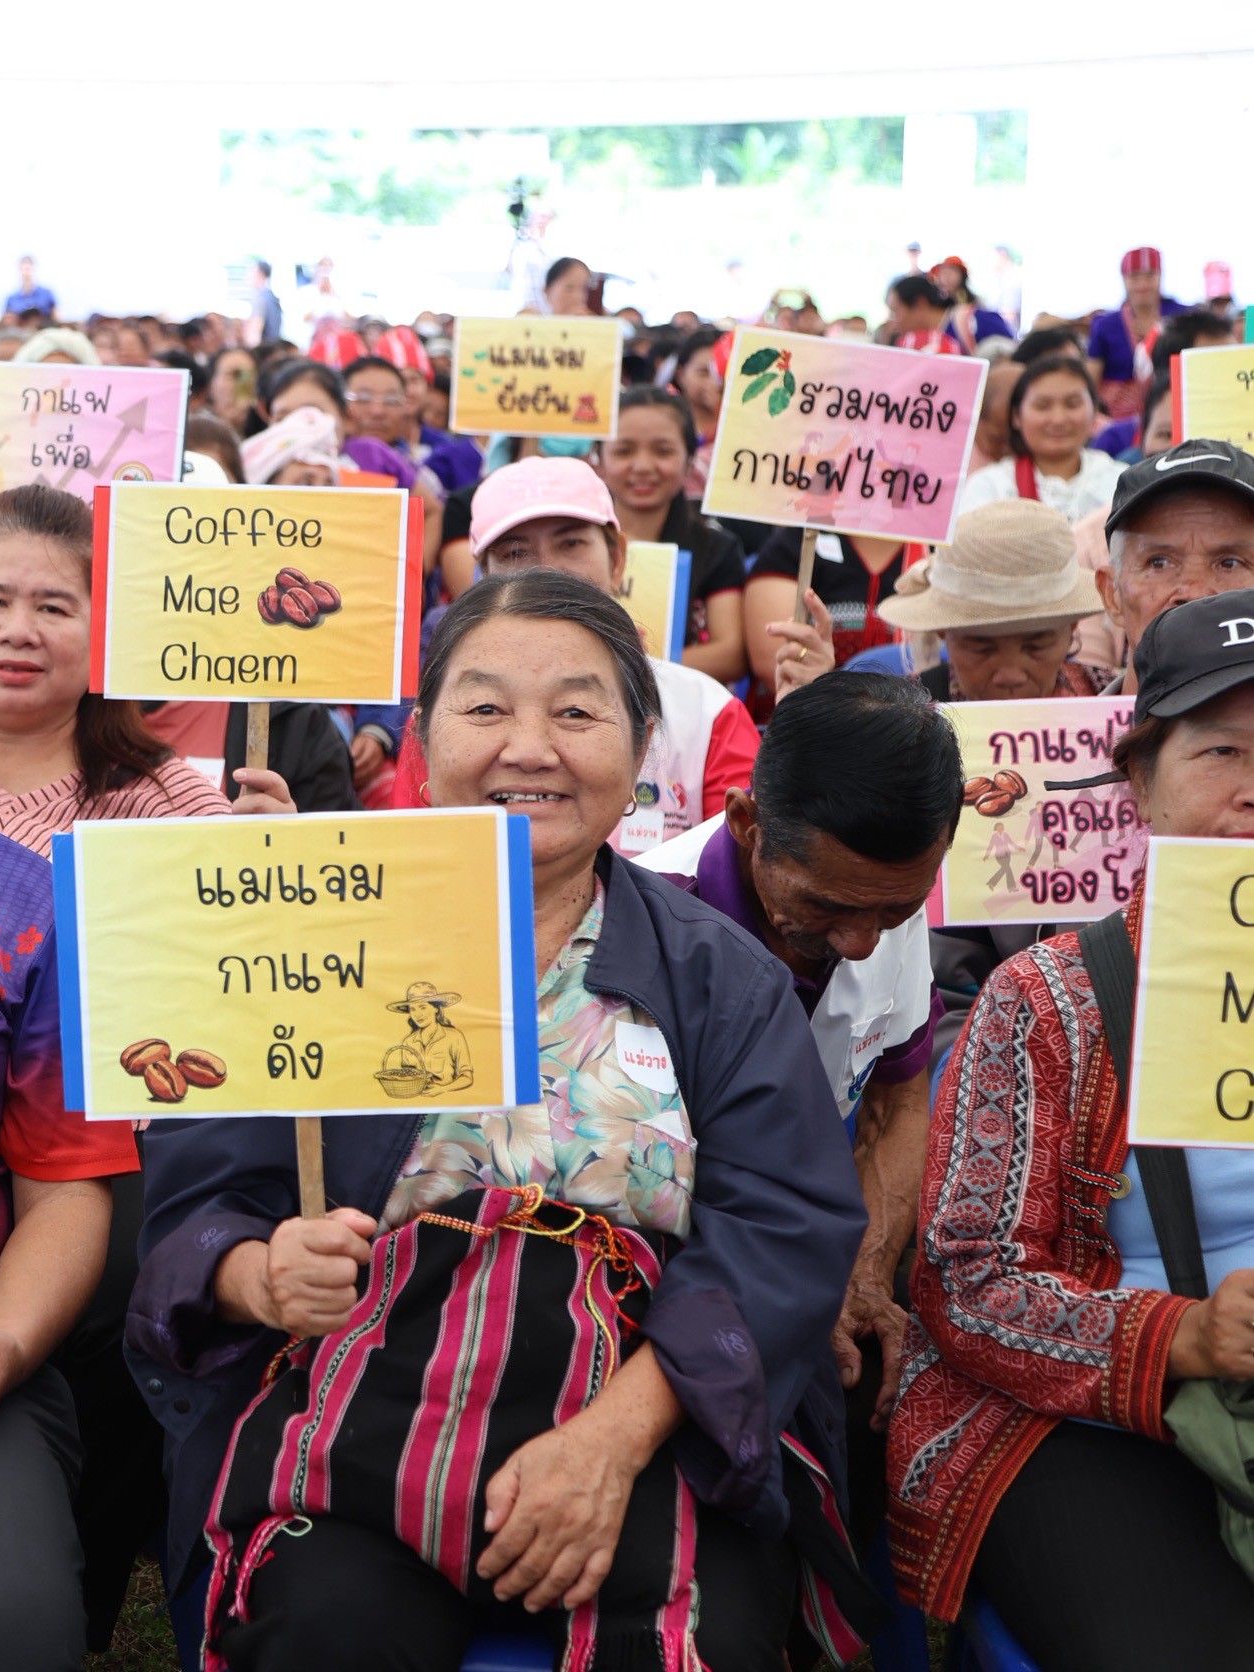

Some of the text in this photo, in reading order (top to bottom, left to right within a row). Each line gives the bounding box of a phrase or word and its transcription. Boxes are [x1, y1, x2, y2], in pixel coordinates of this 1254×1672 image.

[22, 384, 112, 415] กาแฟ
[799, 382, 958, 433] รวมพลัง
[31, 424, 91, 470] เพื่อ
[732, 446, 942, 505] กาแฟไทย
[165, 506, 322, 548] Coffee
[162, 574, 240, 616] Mae
[160, 642, 298, 684] Chaem
[989, 710, 1134, 765] กาแฟ
[1042, 800, 1143, 851] คุณค
[196, 831, 384, 908] แม่แจ่ม
[1020, 848, 1144, 905] ของโ
[217, 940, 366, 994] กาแฟ
[266, 1024, 325, 1081] ดัง
[624, 1048, 667, 1070] แม่วาง
